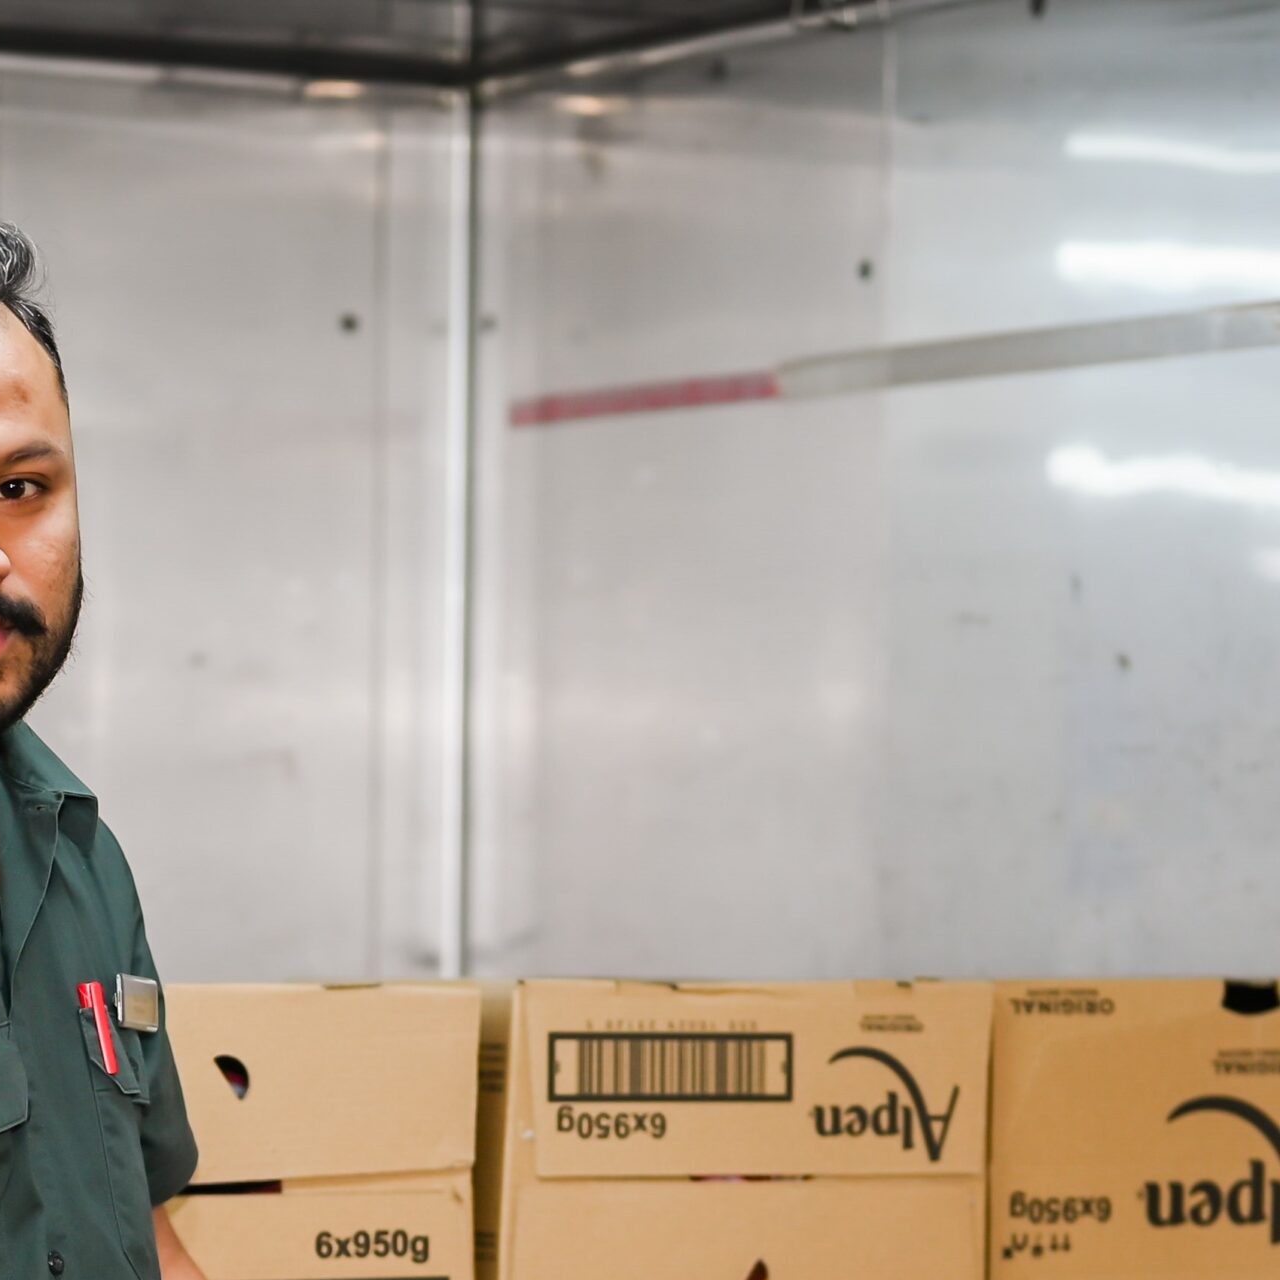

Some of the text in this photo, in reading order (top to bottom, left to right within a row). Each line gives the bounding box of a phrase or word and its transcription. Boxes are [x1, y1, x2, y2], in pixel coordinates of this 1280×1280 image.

[1010, 997, 1115, 1015] ORIGINAL
[813, 1046, 959, 1162] Alpen
[556, 1106, 667, 1139] 6x950g
[1010, 1191, 1112, 1222] 6x950g
[314, 1229, 431, 1263] 6x950g
